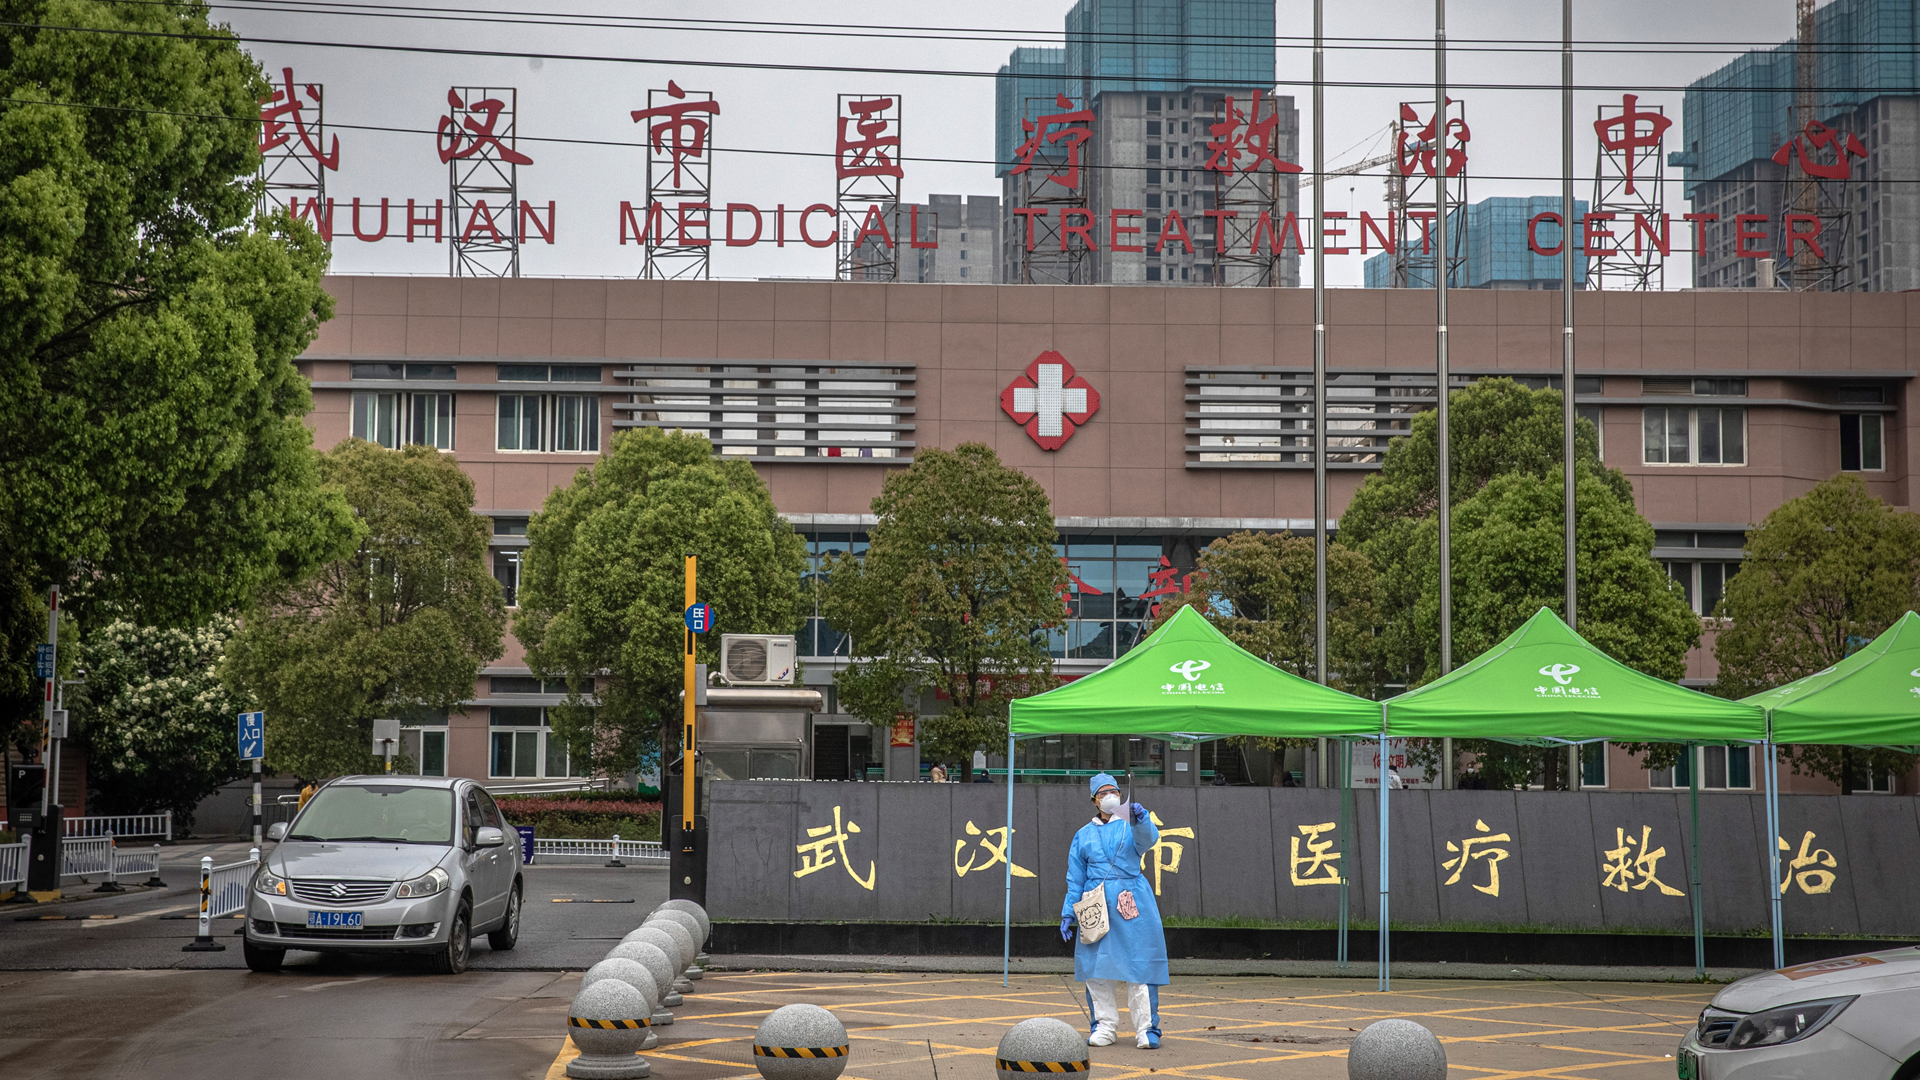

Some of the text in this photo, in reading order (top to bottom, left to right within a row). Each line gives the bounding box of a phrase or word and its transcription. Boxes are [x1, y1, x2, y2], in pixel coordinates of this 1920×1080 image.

[258, 67, 1868, 196] 武汉市医疗救治中心
[290, 196, 1826, 259] WUHAN MEDICAL TREATMENT CENTER
[693, 608, 705, 629] 出口
[1161, 682, 1224, 692] 中国电信
[1534, 685, 1599, 695] 中国电信
[242, 728, 260, 741] 入口
[18, 770, 26, 779] P
[793, 805, 1838, 897] 武汉市医疗救治
